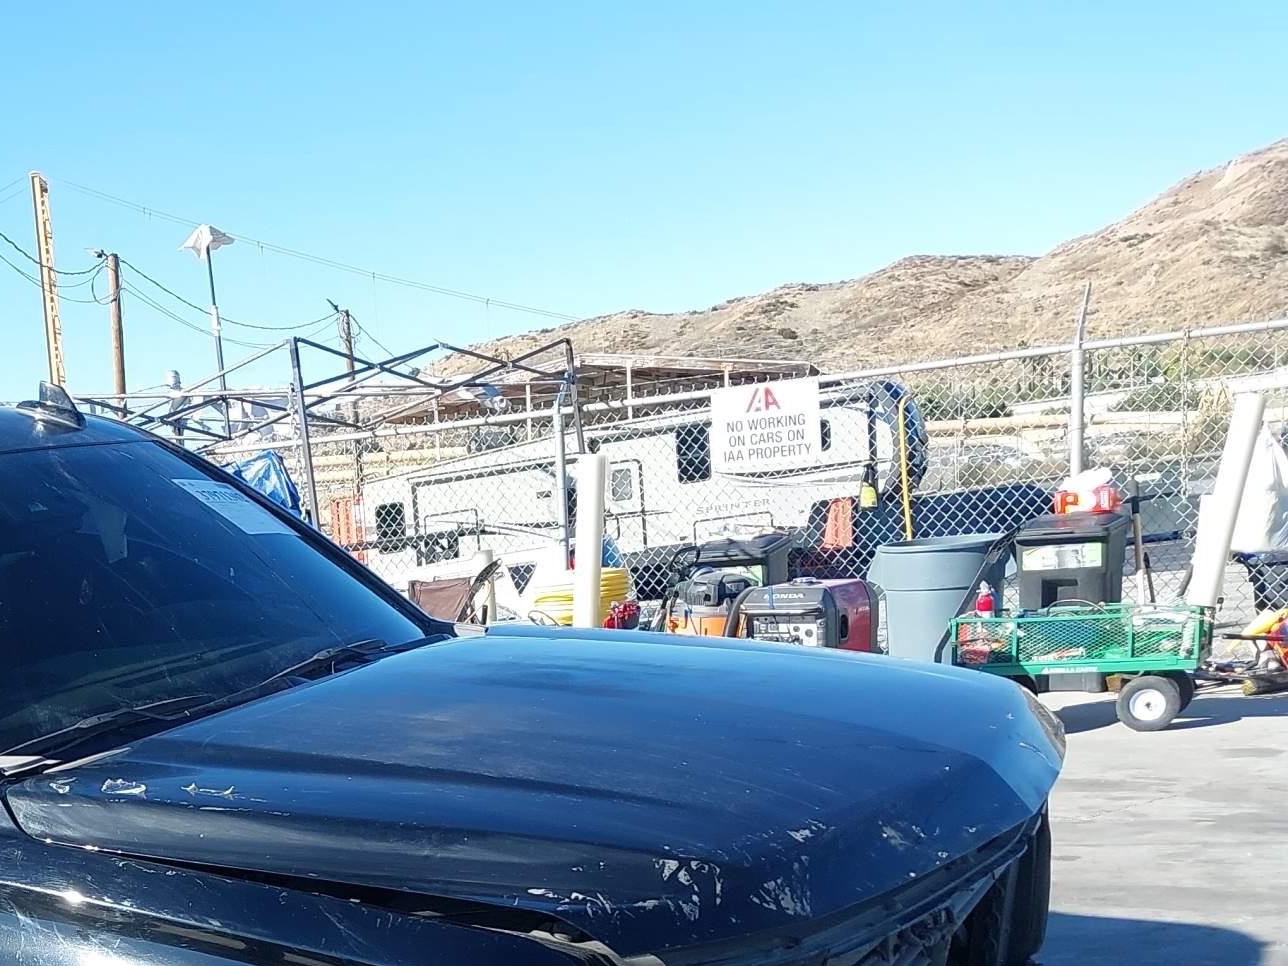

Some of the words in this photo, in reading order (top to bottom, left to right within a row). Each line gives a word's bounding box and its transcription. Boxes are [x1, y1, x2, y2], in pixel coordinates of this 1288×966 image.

[726, 420, 743, 433] NO
[748, 413, 806, 431] WORKING
[729, 434, 745, 447] ON
[750, 430, 783, 445] CARS
[787, 428, 805, 442] ON
[723, 449, 744, 463] IAA
[748, 443, 812, 461] PROPERTY
